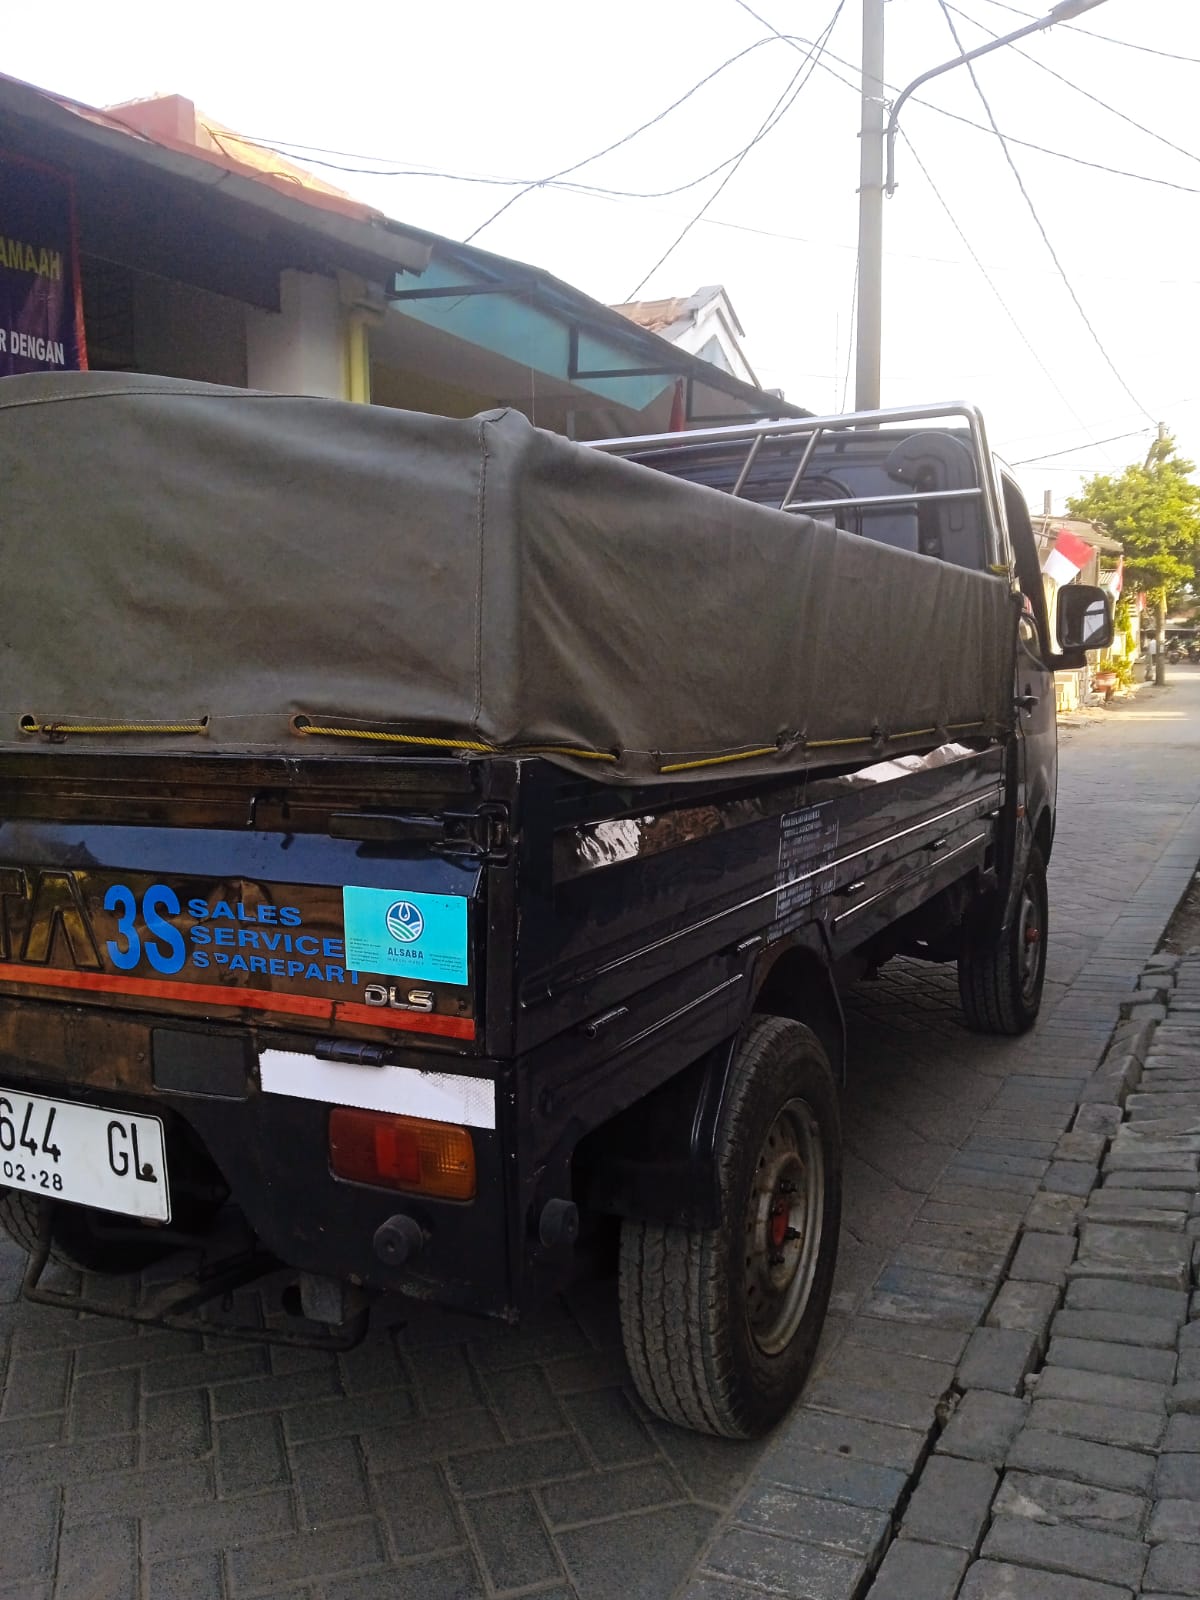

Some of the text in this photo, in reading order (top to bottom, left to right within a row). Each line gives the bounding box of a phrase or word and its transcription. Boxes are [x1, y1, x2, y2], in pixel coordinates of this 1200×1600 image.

[0, 236, 61, 280] AMAAH
[10, 333, 65, 365] DENGAN
[187, 898, 303, 927] SALES
[103, 884, 187, 975] 3S
[190, 925, 345, 958] SERVICE
[387, 946, 424, 960] ALSABA
[364, 984, 434, 1012] DLS
[0, 1096, 158, 1184] 644 GL
